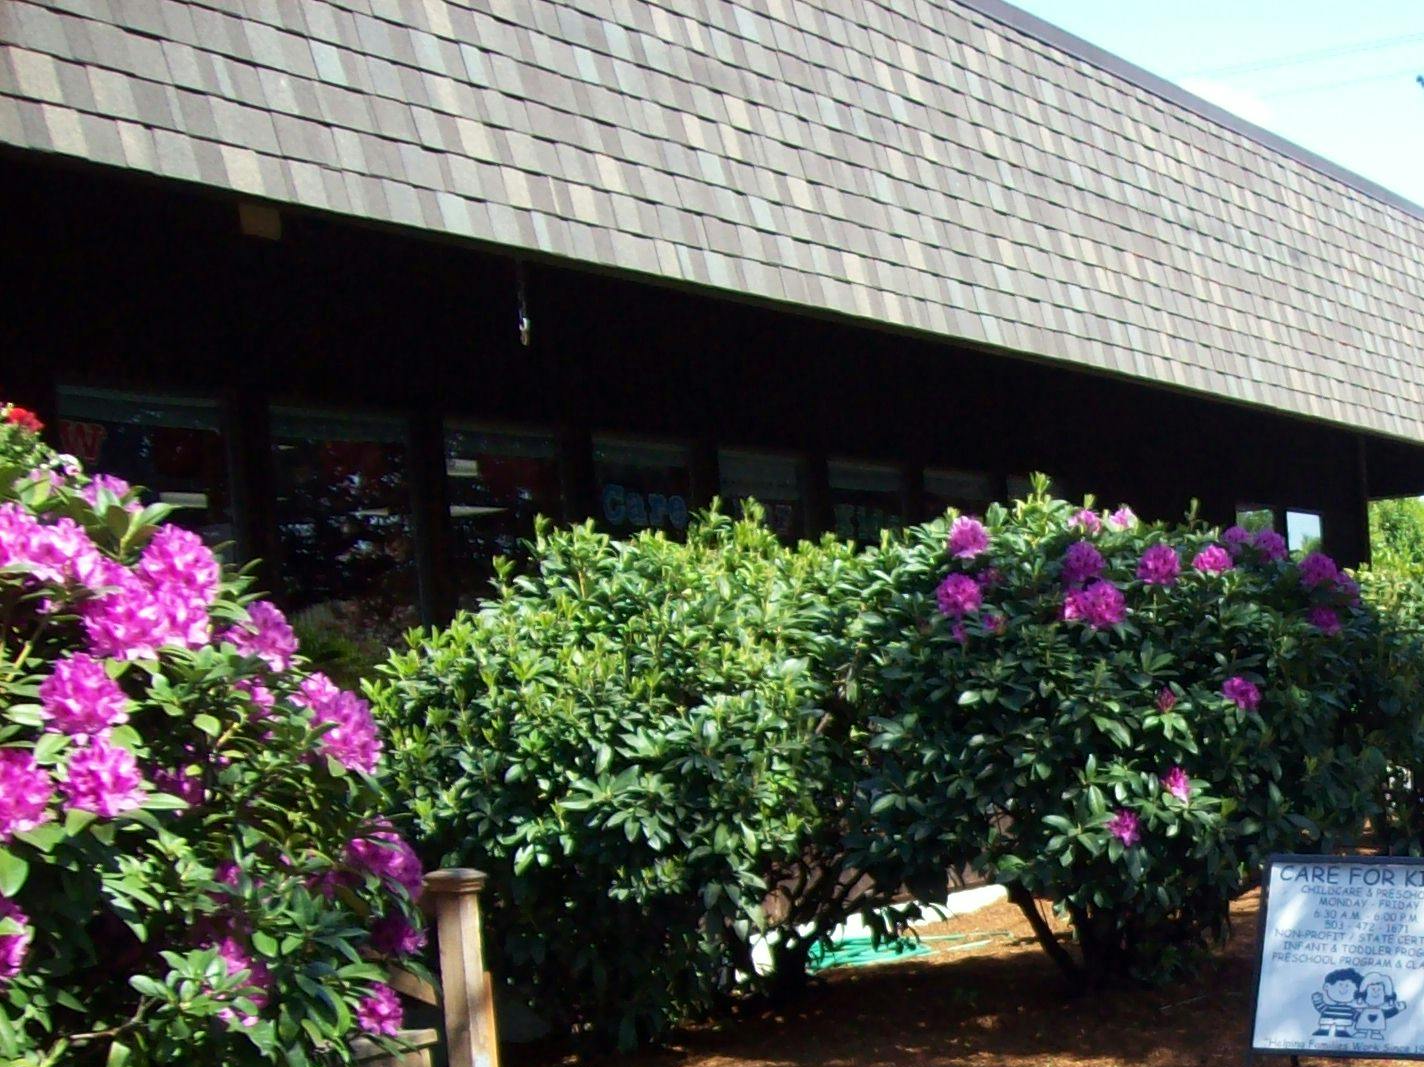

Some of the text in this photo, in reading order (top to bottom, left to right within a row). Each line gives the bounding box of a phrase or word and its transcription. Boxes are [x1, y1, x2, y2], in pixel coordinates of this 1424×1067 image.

[601, 482, 688, 530] Care
[1280, 865, 1339, 884] CARE
[1349, 867, 1396, 886] FOR
[1301, 884, 1363, 897] CHILDCARE
[1319, 897, 1367, 908] MONDAY
[1379, 899, 1420, 910] FRIDAY
[1355, 921, 1375, 932] 472
[1275, 928, 1346, 940] NON-PROFIT
[1359, 933, 1394, 944] STATE
[1284, 941, 1328, 952] INFANT
[1343, 944, 1391, 956] TODDLER
[1272, 952, 1336, 965] PRESCHOOL
[1339, 956, 1391, 968] PROGRAM
